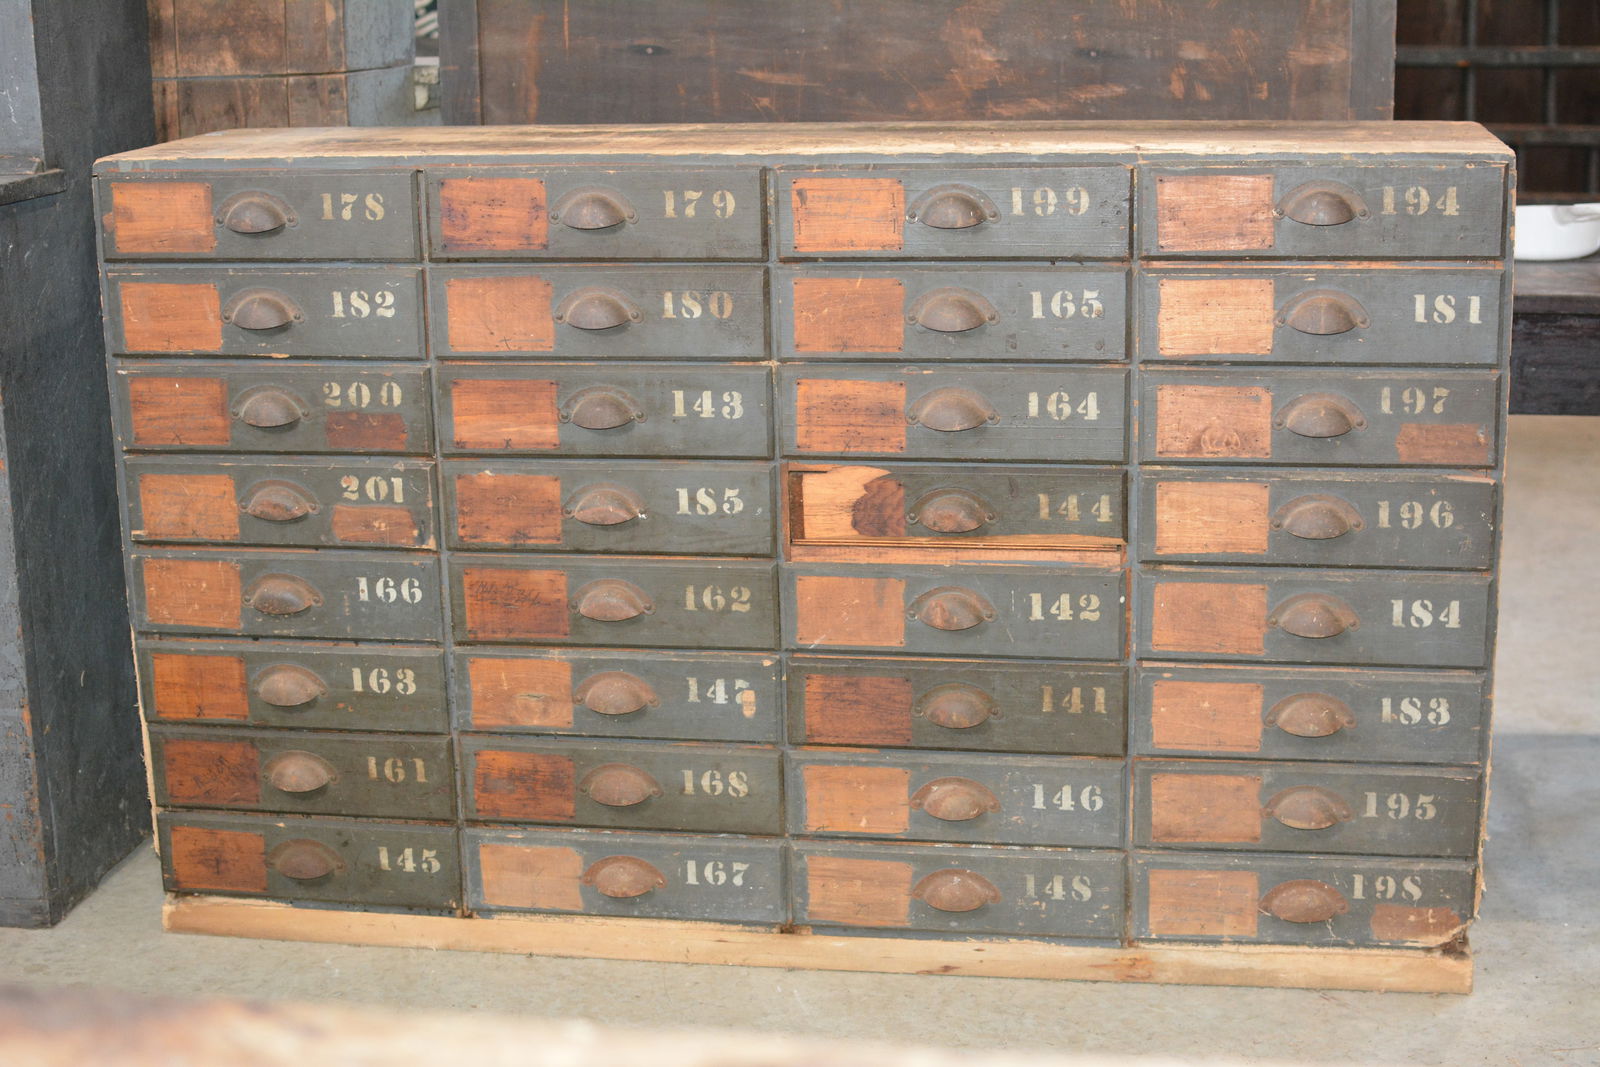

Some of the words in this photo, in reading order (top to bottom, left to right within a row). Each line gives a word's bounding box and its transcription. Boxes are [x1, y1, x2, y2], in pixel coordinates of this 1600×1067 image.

[321, 192, 384, 221] 178
[664, 190, 736, 219] 179
[1010, 186, 1091, 216] 199
[1381, 186, 1460, 216] 194
[331, 290, 396, 318] 182
[662, 291, 732, 319] 180
[1031, 289, 1103, 319] 165
[1414, 293, 1482, 324] 181
[323, 381, 402, 408] 200
[672, 389, 744, 420] 143
[1028, 391, 1101, 420] 164
[1380, 386, 1451, 414] 197
[341, 475, 405, 503] 201
[675, 487, 744, 515] 185
[1038, 493, 1114, 522] 144
[1376, 500, 1455, 528] 196
[356, 576, 423, 604] 166
[684, 585, 752, 613] 162
[1029, 593, 1101, 621] 142
[1391, 599, 1461, 628] 184
[352, 668, 416, 695] 163
[1042, 687, 1108, 714] 141
[1381, 697, 1451, 726] 183
[367, 756, 428, 783] 161
[681, 770, 749, 797] 168
[1031, 784, 1104, 811] 146
[1364, 792, 1437, 820] 195
[378, 847, 441, 873] 145
[684, 860, 750, 886] 167
[1025, 874, 1092, 902] 148
[1350, 874, 1424, 902] 198
